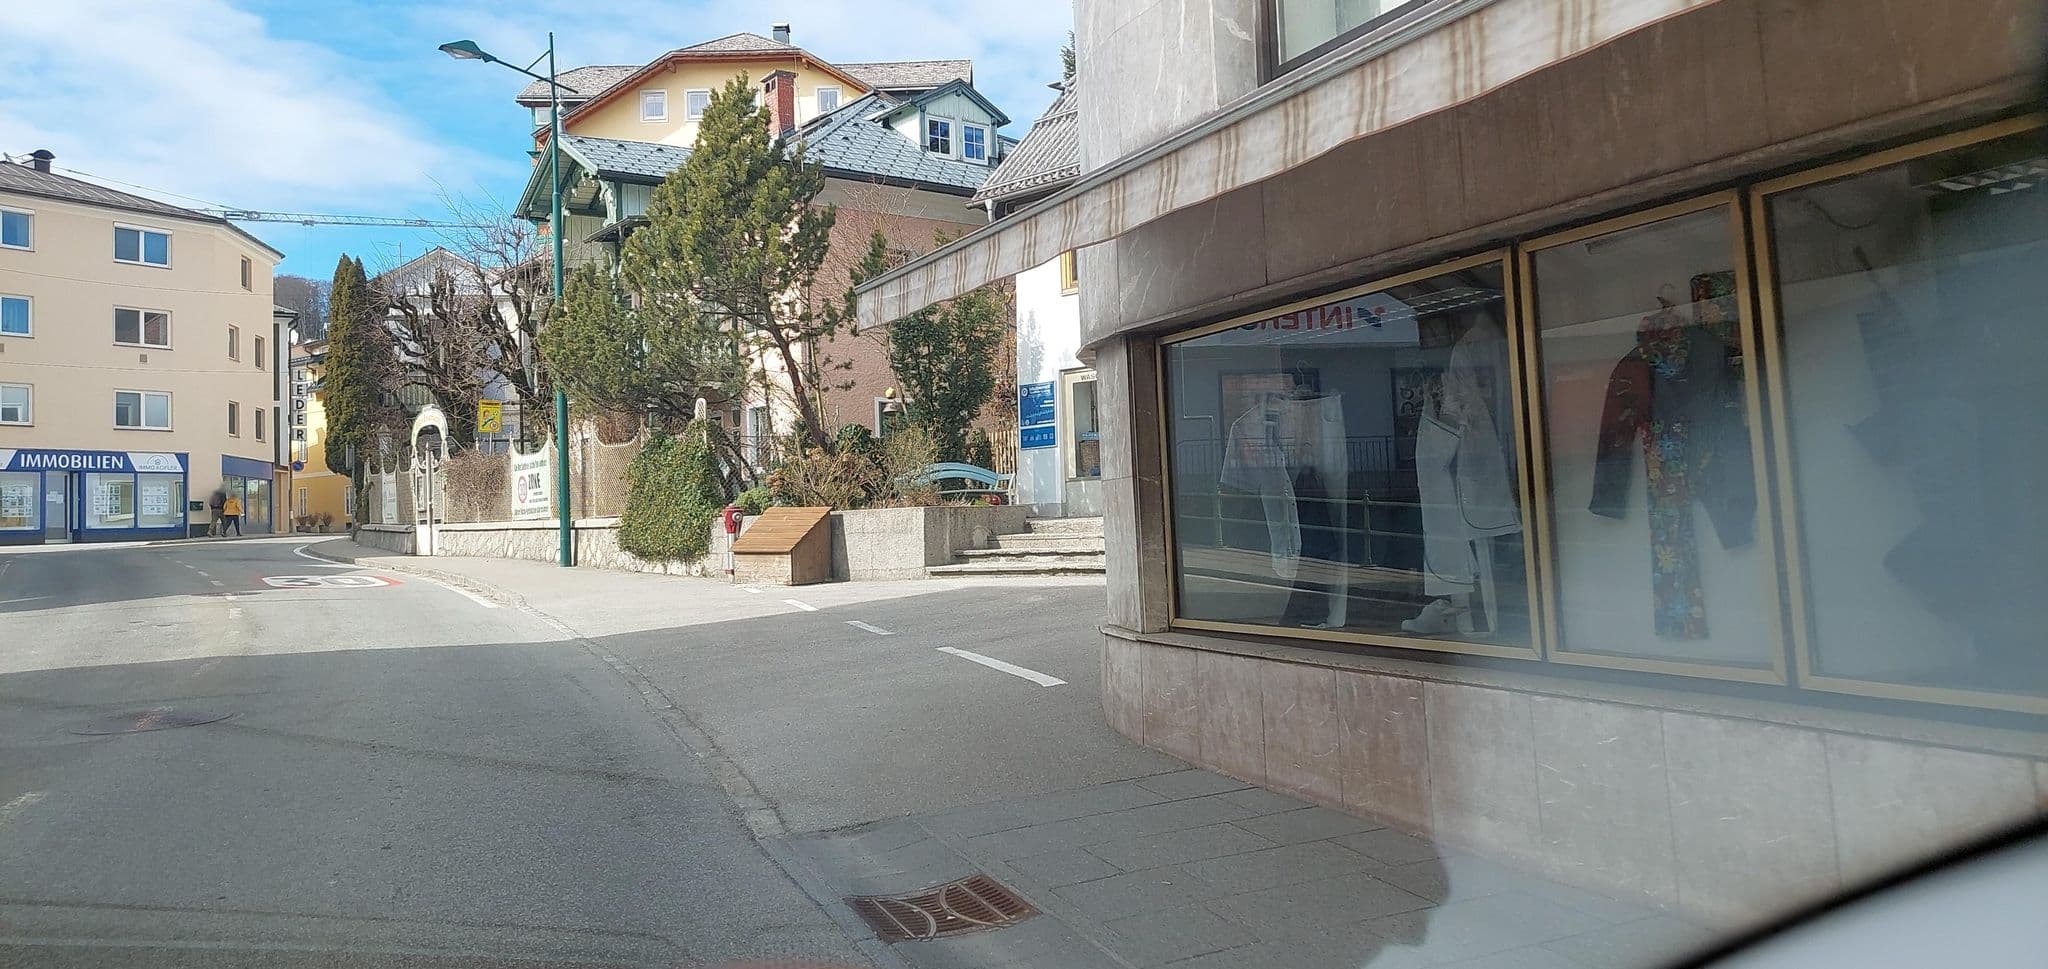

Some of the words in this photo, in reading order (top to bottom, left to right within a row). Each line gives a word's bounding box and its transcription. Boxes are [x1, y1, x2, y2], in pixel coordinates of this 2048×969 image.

[296, 370, 304, 440] LEDER
[20, 453, 124, 469] IMMOBILIEN
[264, 577, 378, 587] 30
